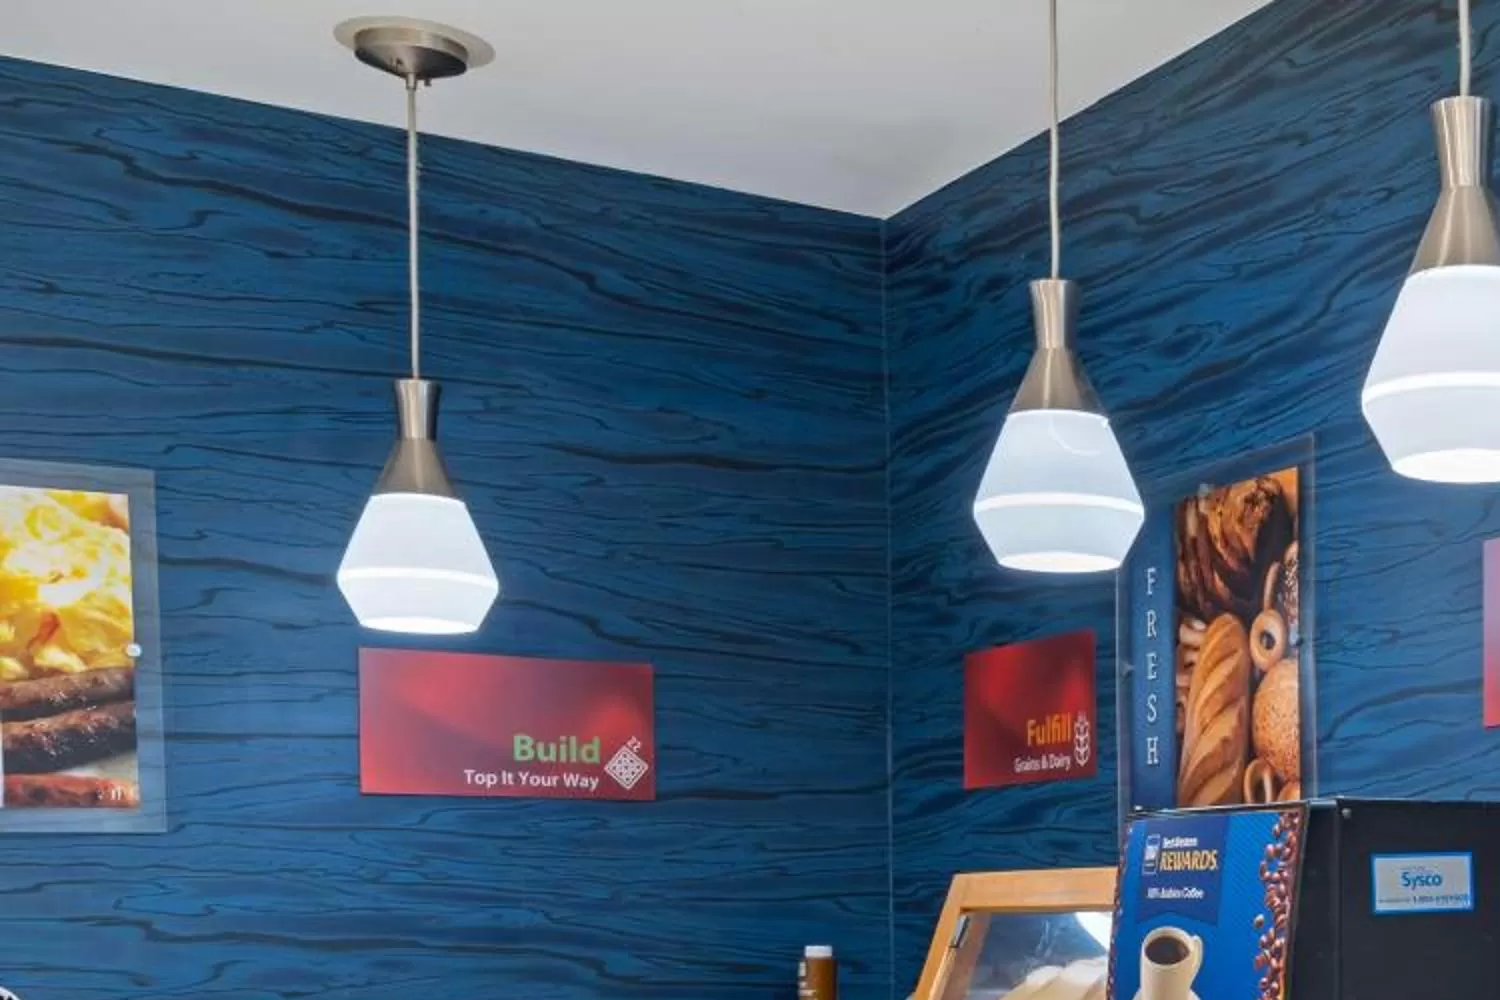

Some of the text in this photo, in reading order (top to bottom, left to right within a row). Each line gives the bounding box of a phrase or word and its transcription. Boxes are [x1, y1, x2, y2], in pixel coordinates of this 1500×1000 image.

[1145, 567, 1160, 766] FRESH
[1027, 712, 1072, 747] Fulfill
[513, 733, 600, 764] Build
[1013, 753, 1072, 773] Grains & Dairy
[464, 769, 600, 791] Top It Your Way
[1160, 849, 1218, 873] REWARDS
[1401, 871, 1442, 891] Sysco
